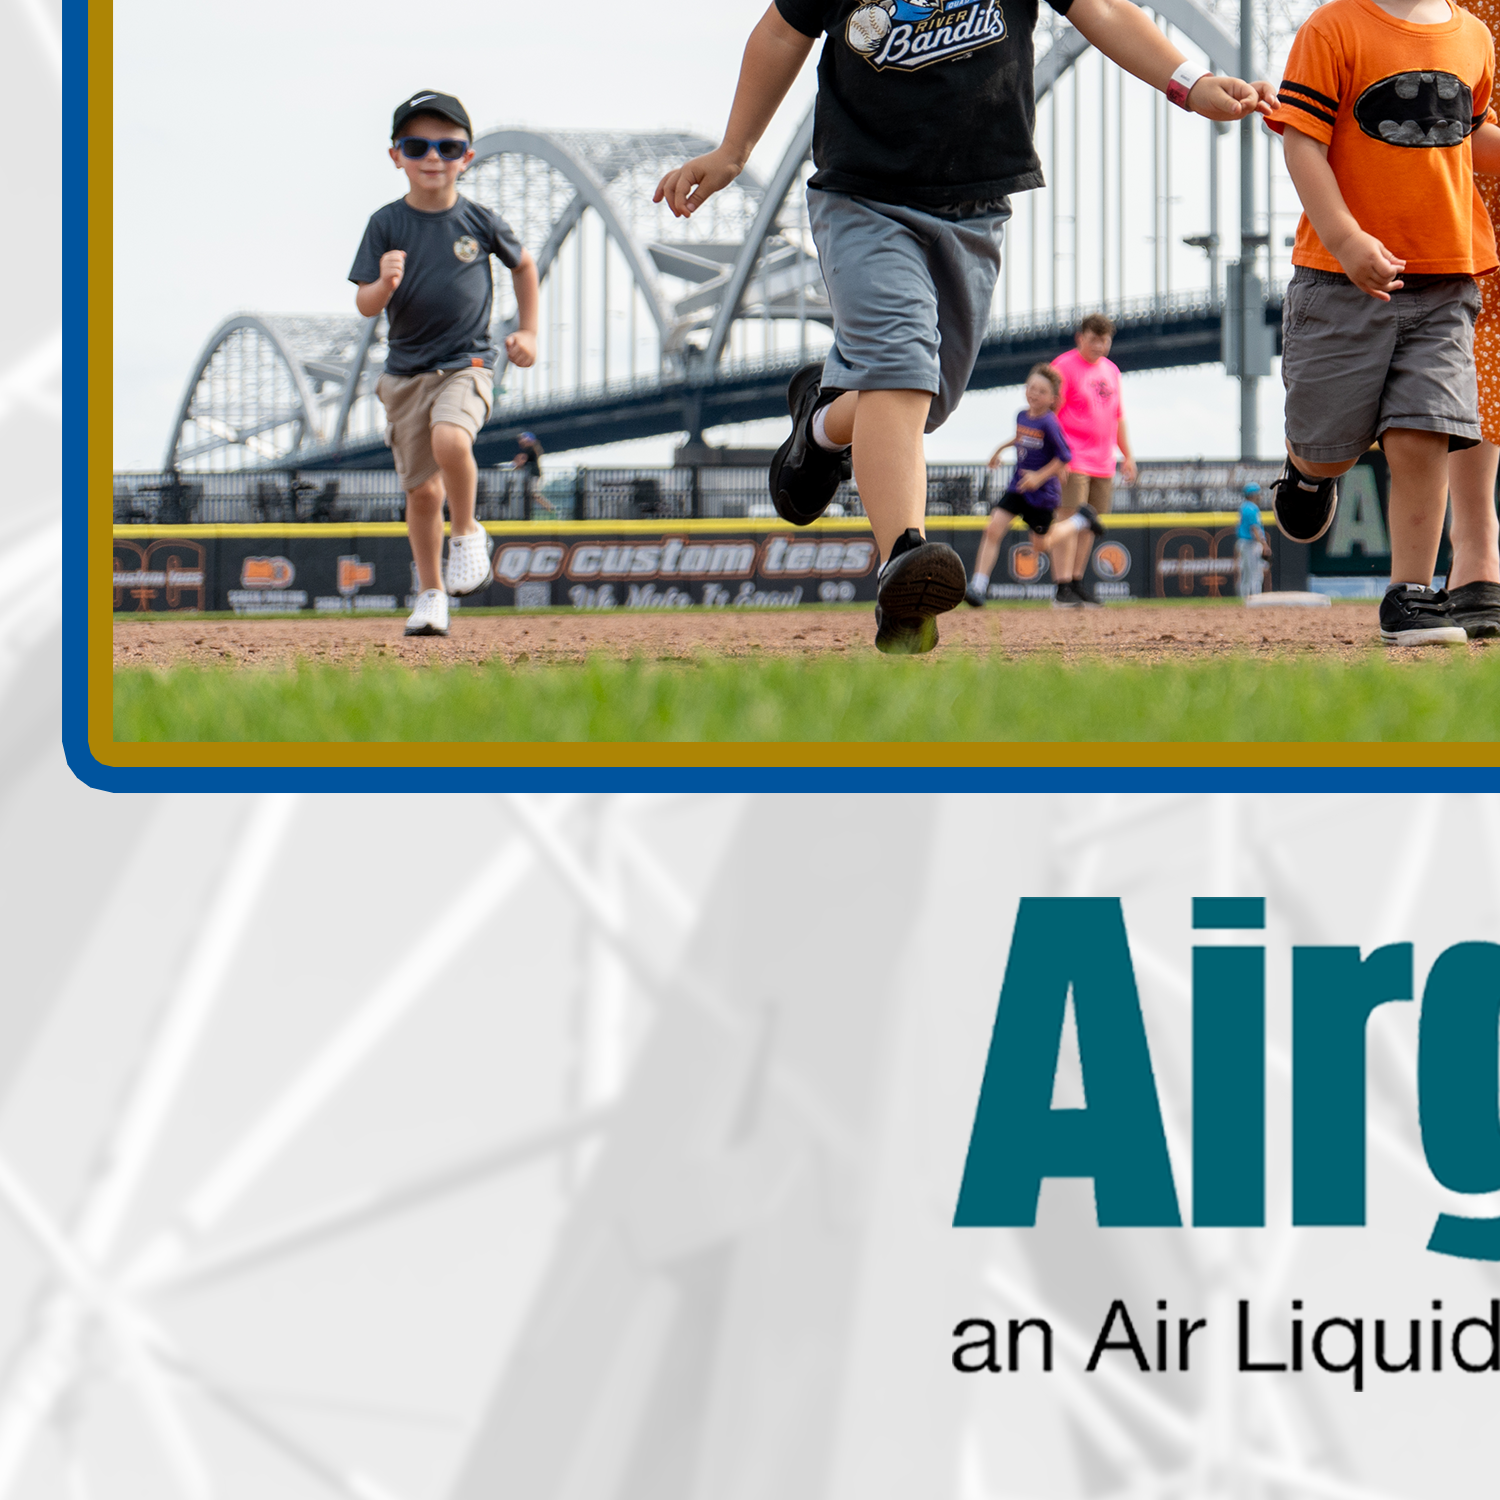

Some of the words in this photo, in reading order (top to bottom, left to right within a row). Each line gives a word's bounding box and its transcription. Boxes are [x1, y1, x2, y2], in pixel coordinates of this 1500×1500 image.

[874, 0, 1005, 65] Bandits
[914, 9, 968, 34] RIVER
[571, 537, 756, 574] custom
[764, 536, 875, 572] tees
